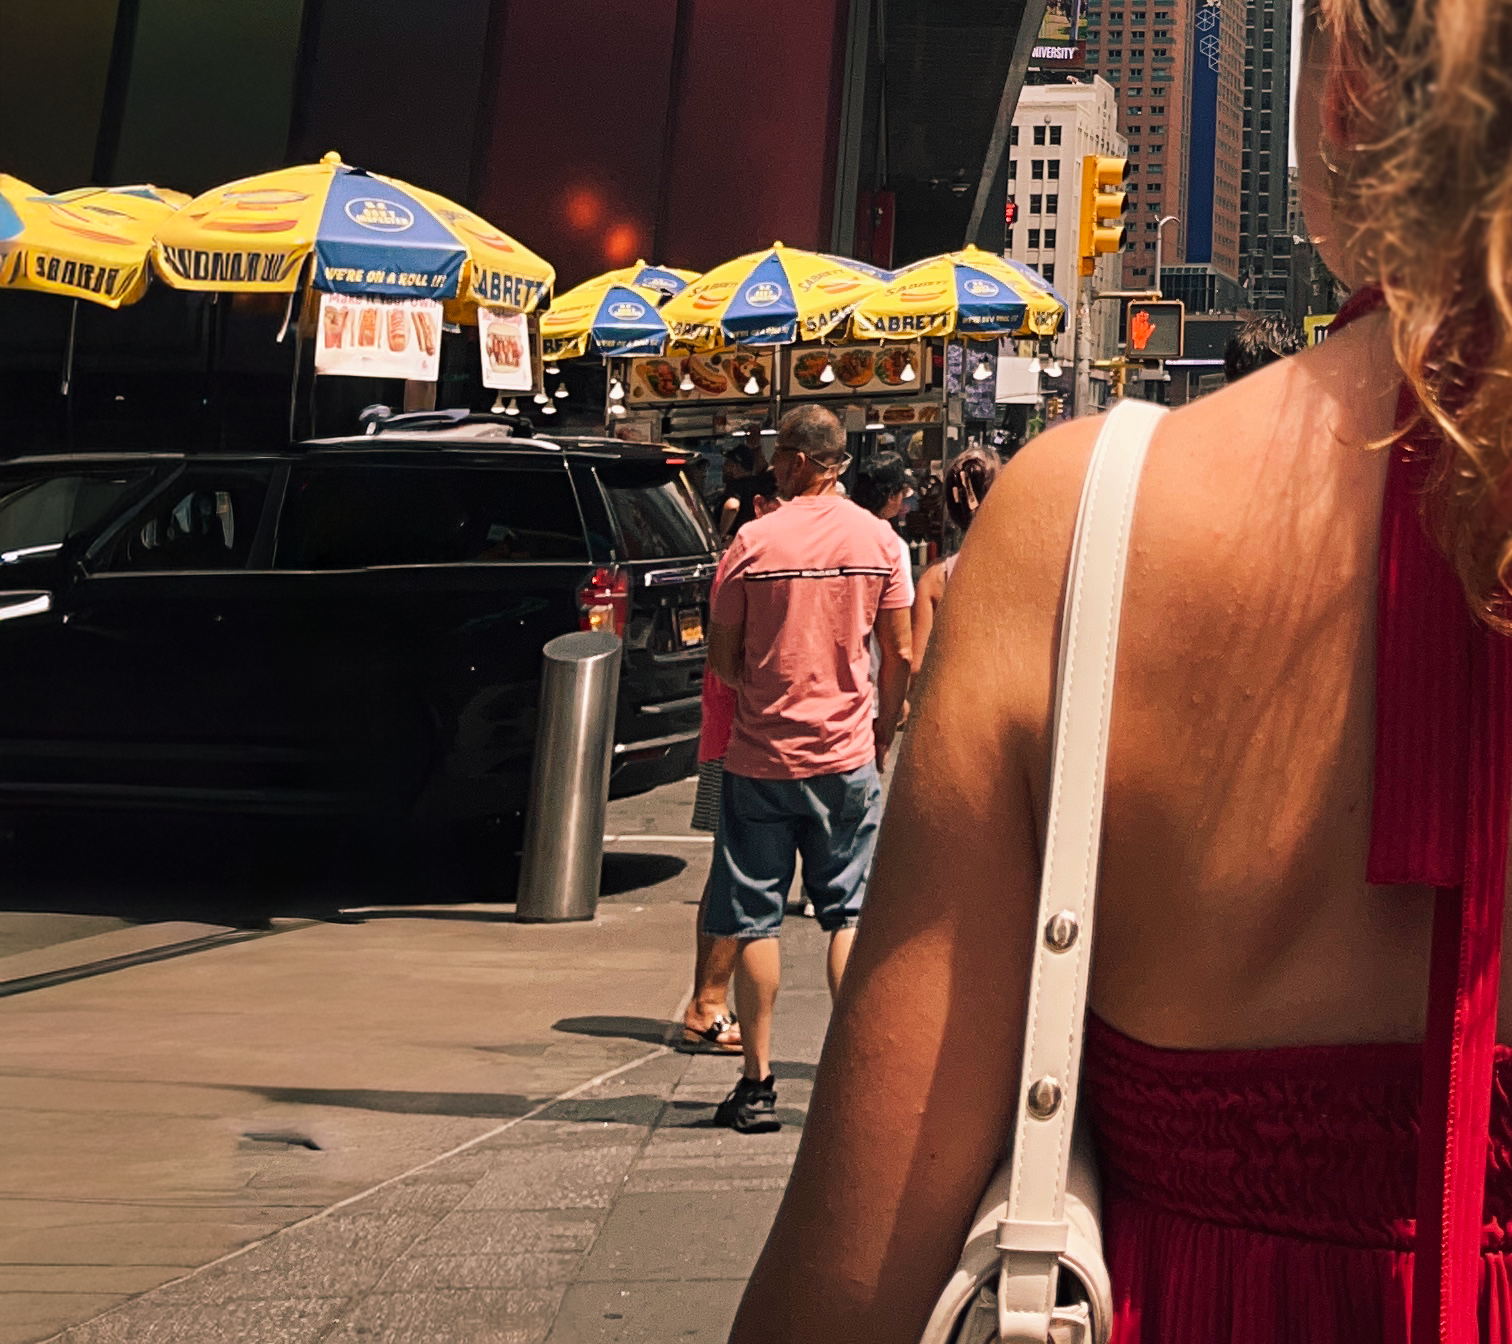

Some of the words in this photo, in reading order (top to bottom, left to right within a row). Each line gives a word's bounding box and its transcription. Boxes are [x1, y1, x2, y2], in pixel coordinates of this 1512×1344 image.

[366, 269, 386, 284] ON
[386, 272, 397, 285] A
[398, 273, 428, 287] ROLL
